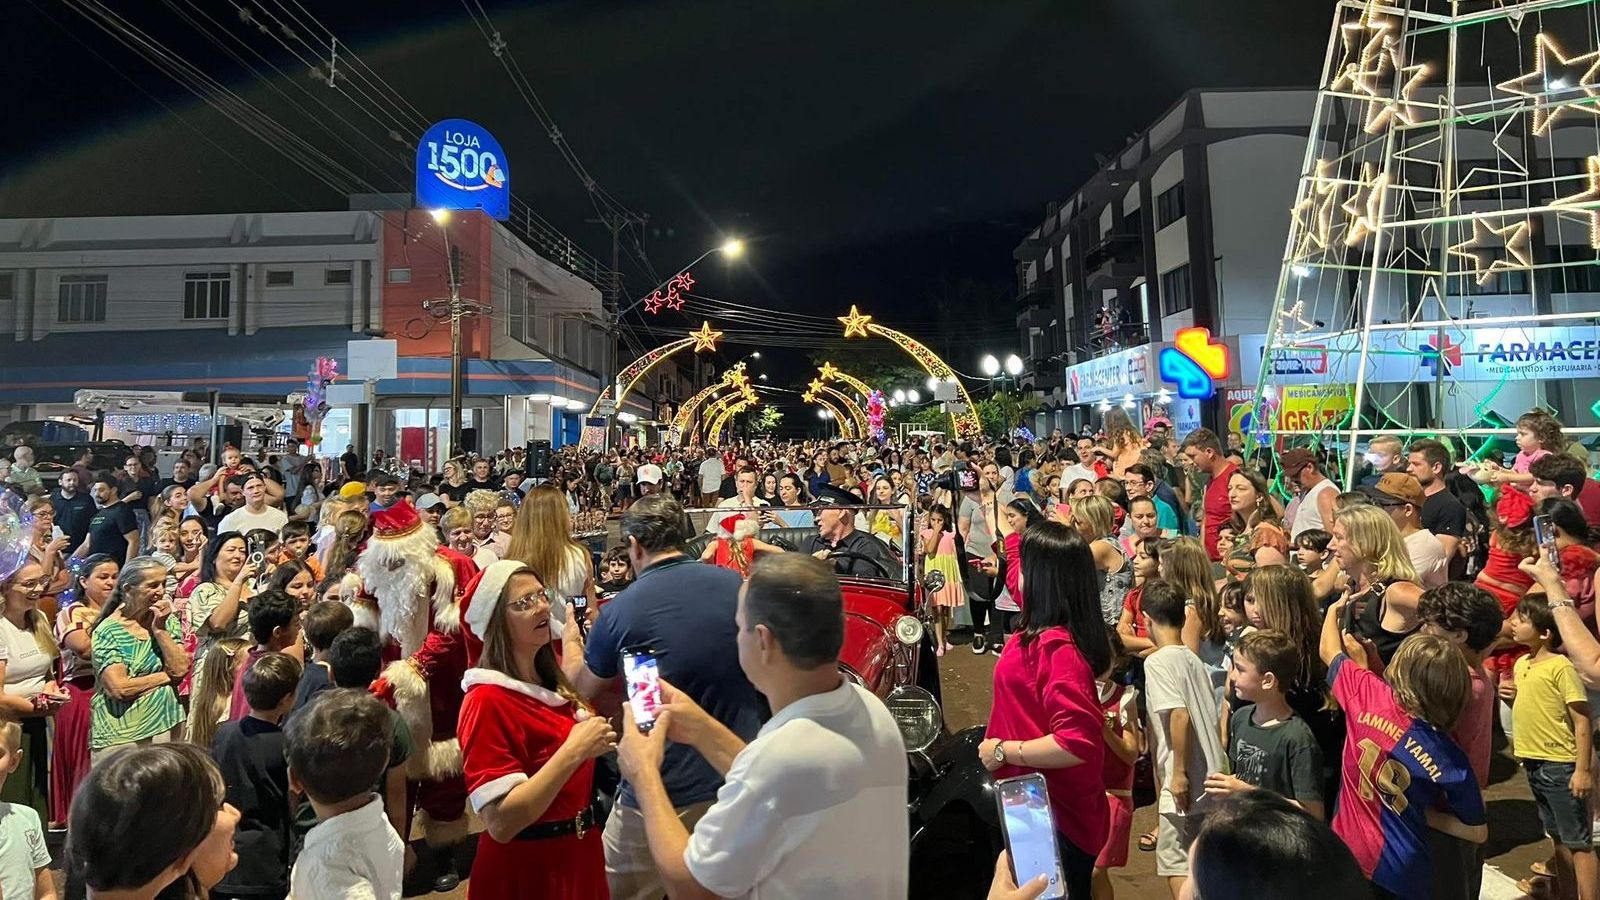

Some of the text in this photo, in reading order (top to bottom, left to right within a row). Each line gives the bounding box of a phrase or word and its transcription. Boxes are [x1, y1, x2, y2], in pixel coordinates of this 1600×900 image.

[446, 130, 480, 149] LOJA
[428, 141, 497, 183] 1500
[1478, 340, 1600, 362] FARMACE
[1357, 711, 1405, 742] LAMINE
[1404, 736, 1442, 783] YAMAL
